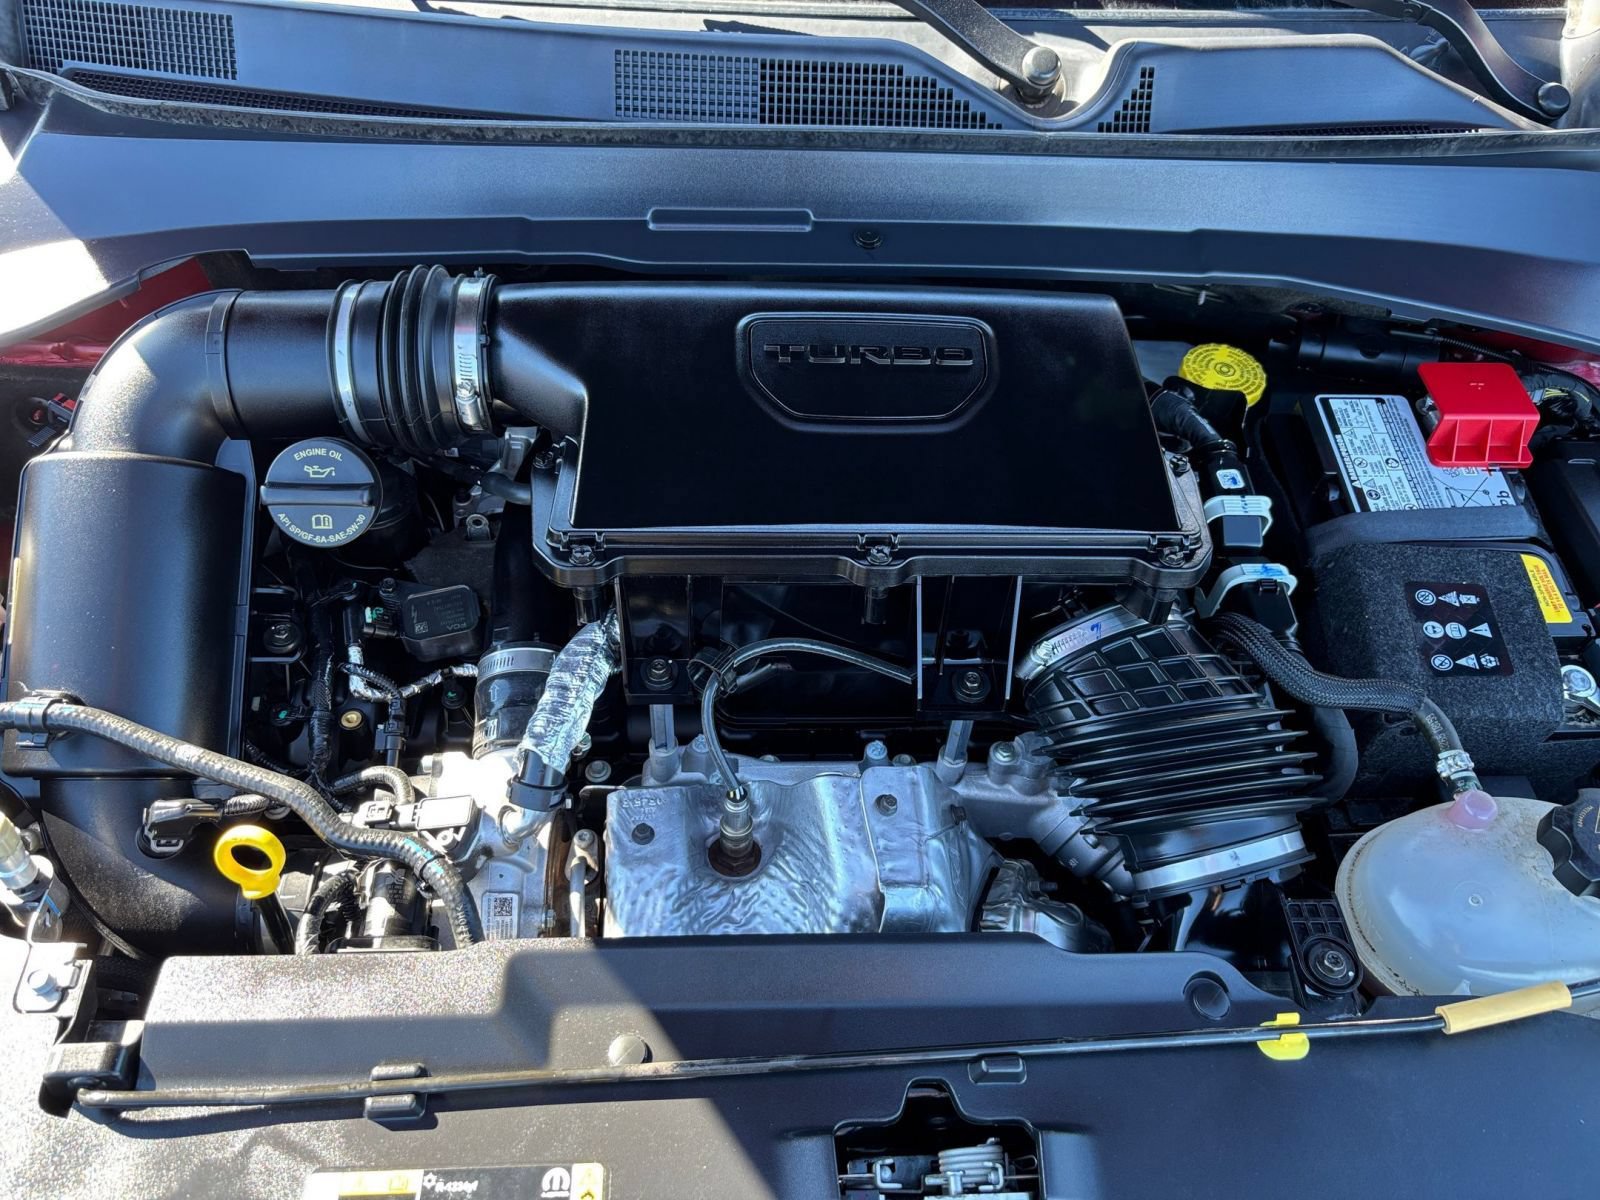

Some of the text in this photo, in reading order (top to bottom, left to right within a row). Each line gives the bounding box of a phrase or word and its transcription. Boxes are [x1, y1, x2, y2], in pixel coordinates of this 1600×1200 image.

[764, 345, 973, 365] TURBO
[293, 448, 343, 462] ENGINE OIL
[277, 513, 291, 527] API
